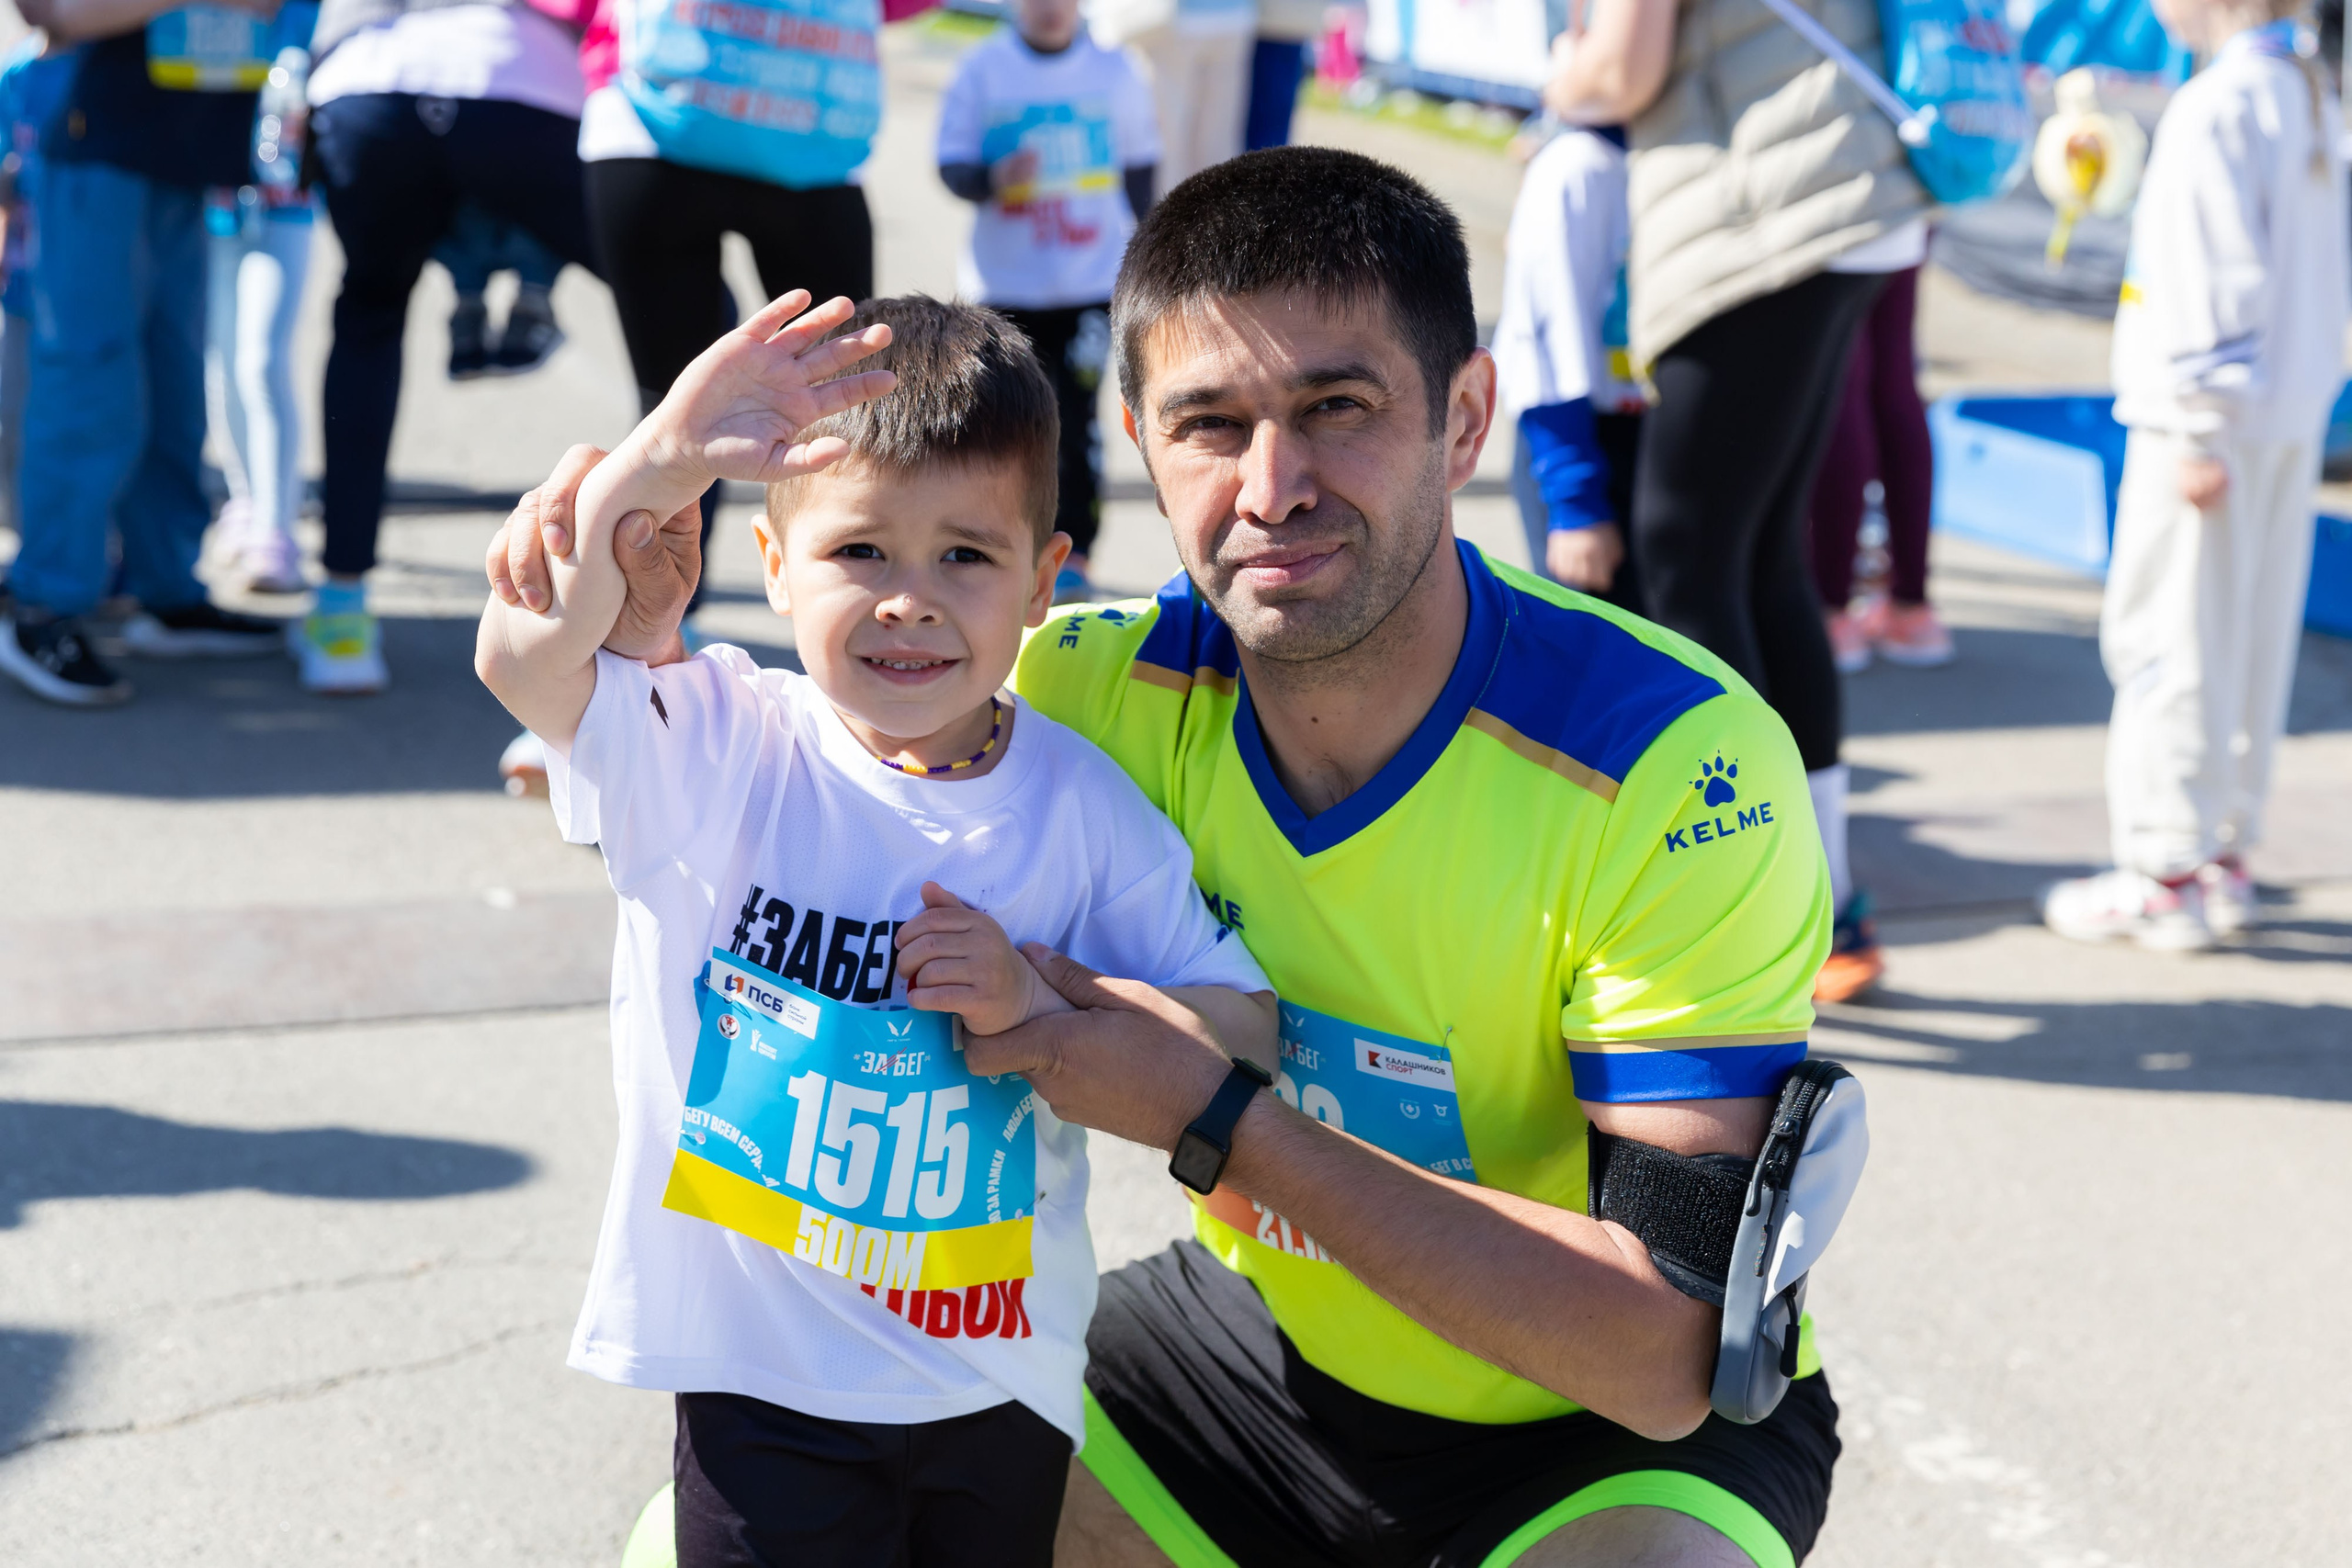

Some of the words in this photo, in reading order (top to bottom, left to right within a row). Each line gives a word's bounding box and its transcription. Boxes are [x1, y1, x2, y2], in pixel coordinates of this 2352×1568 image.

[1665, 801, 1775, 853] KELME
[748, 985, 784, 1013] ПСБ
[1385, 1055, 1447, 1076] КАЛАШНИКОВ
[1385, 1063, 1413, 1075] СПОРТ
[684, 1105, 711, 1128] БЕГУ
[710, 1114, 741, 1145] ВСЕМ
[785, 1069, 969, 1220] 1515
[987, 1149, 1006, 1193] РАМКИ
[987, 1193, 1001, 1212] ЗА
